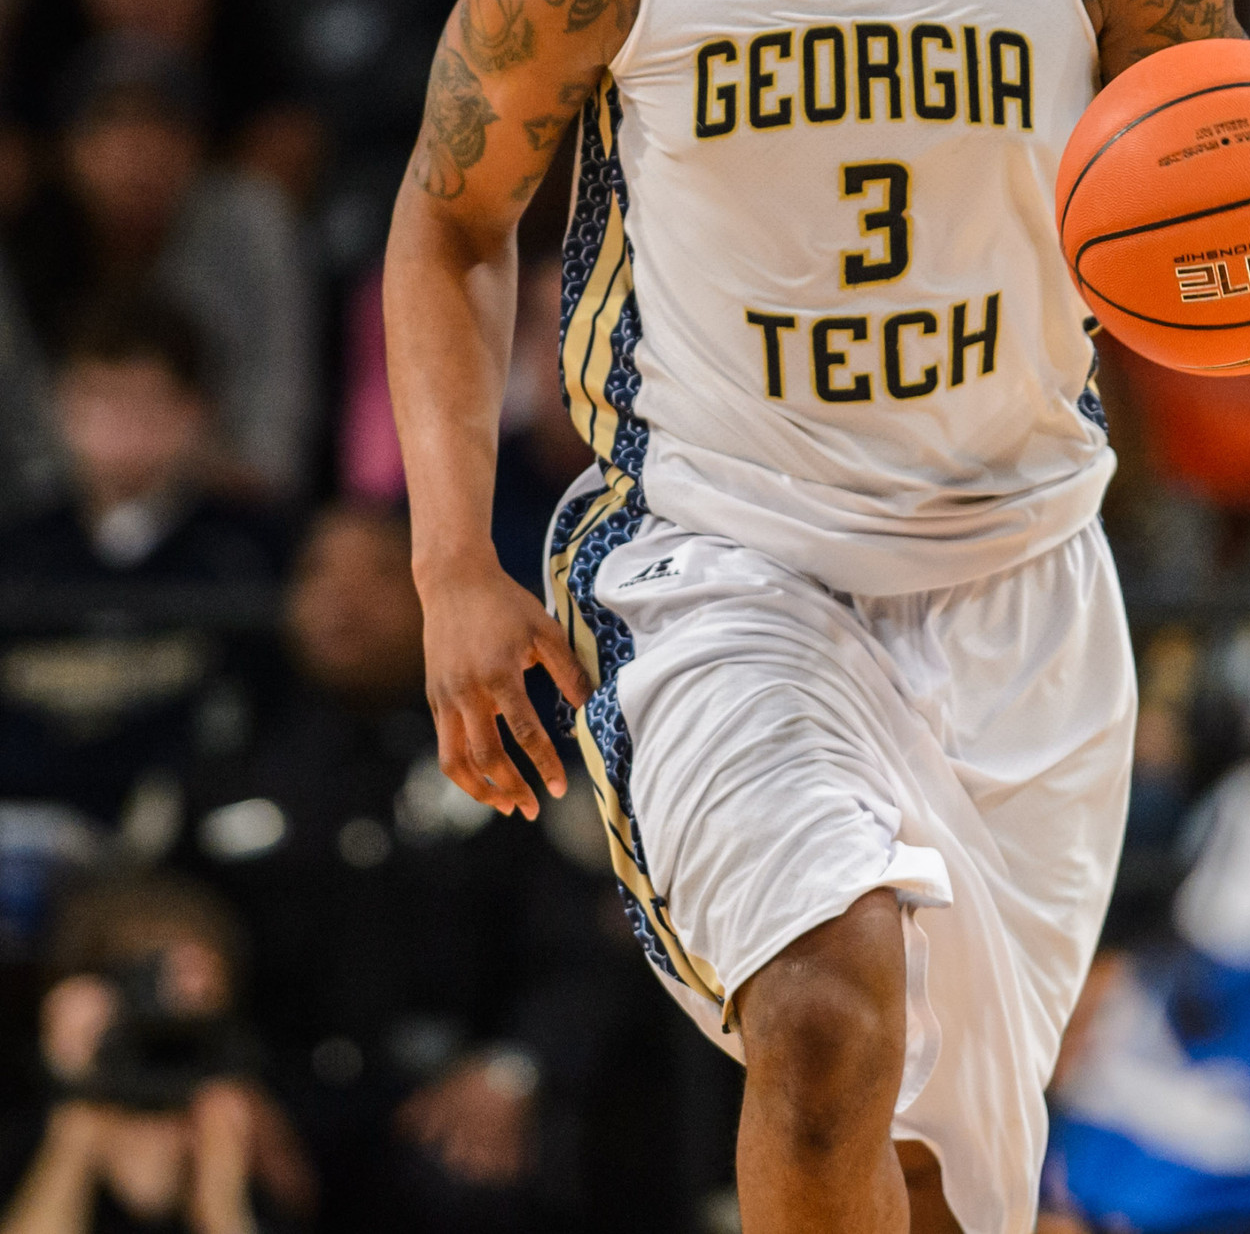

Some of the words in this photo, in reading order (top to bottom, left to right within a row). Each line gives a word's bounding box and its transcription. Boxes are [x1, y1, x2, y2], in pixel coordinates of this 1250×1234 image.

[694, 22, 1034, 139] GEORGIA
[838, 159, 913, 290] 3
[745, 290, 1002, 404] TECH
